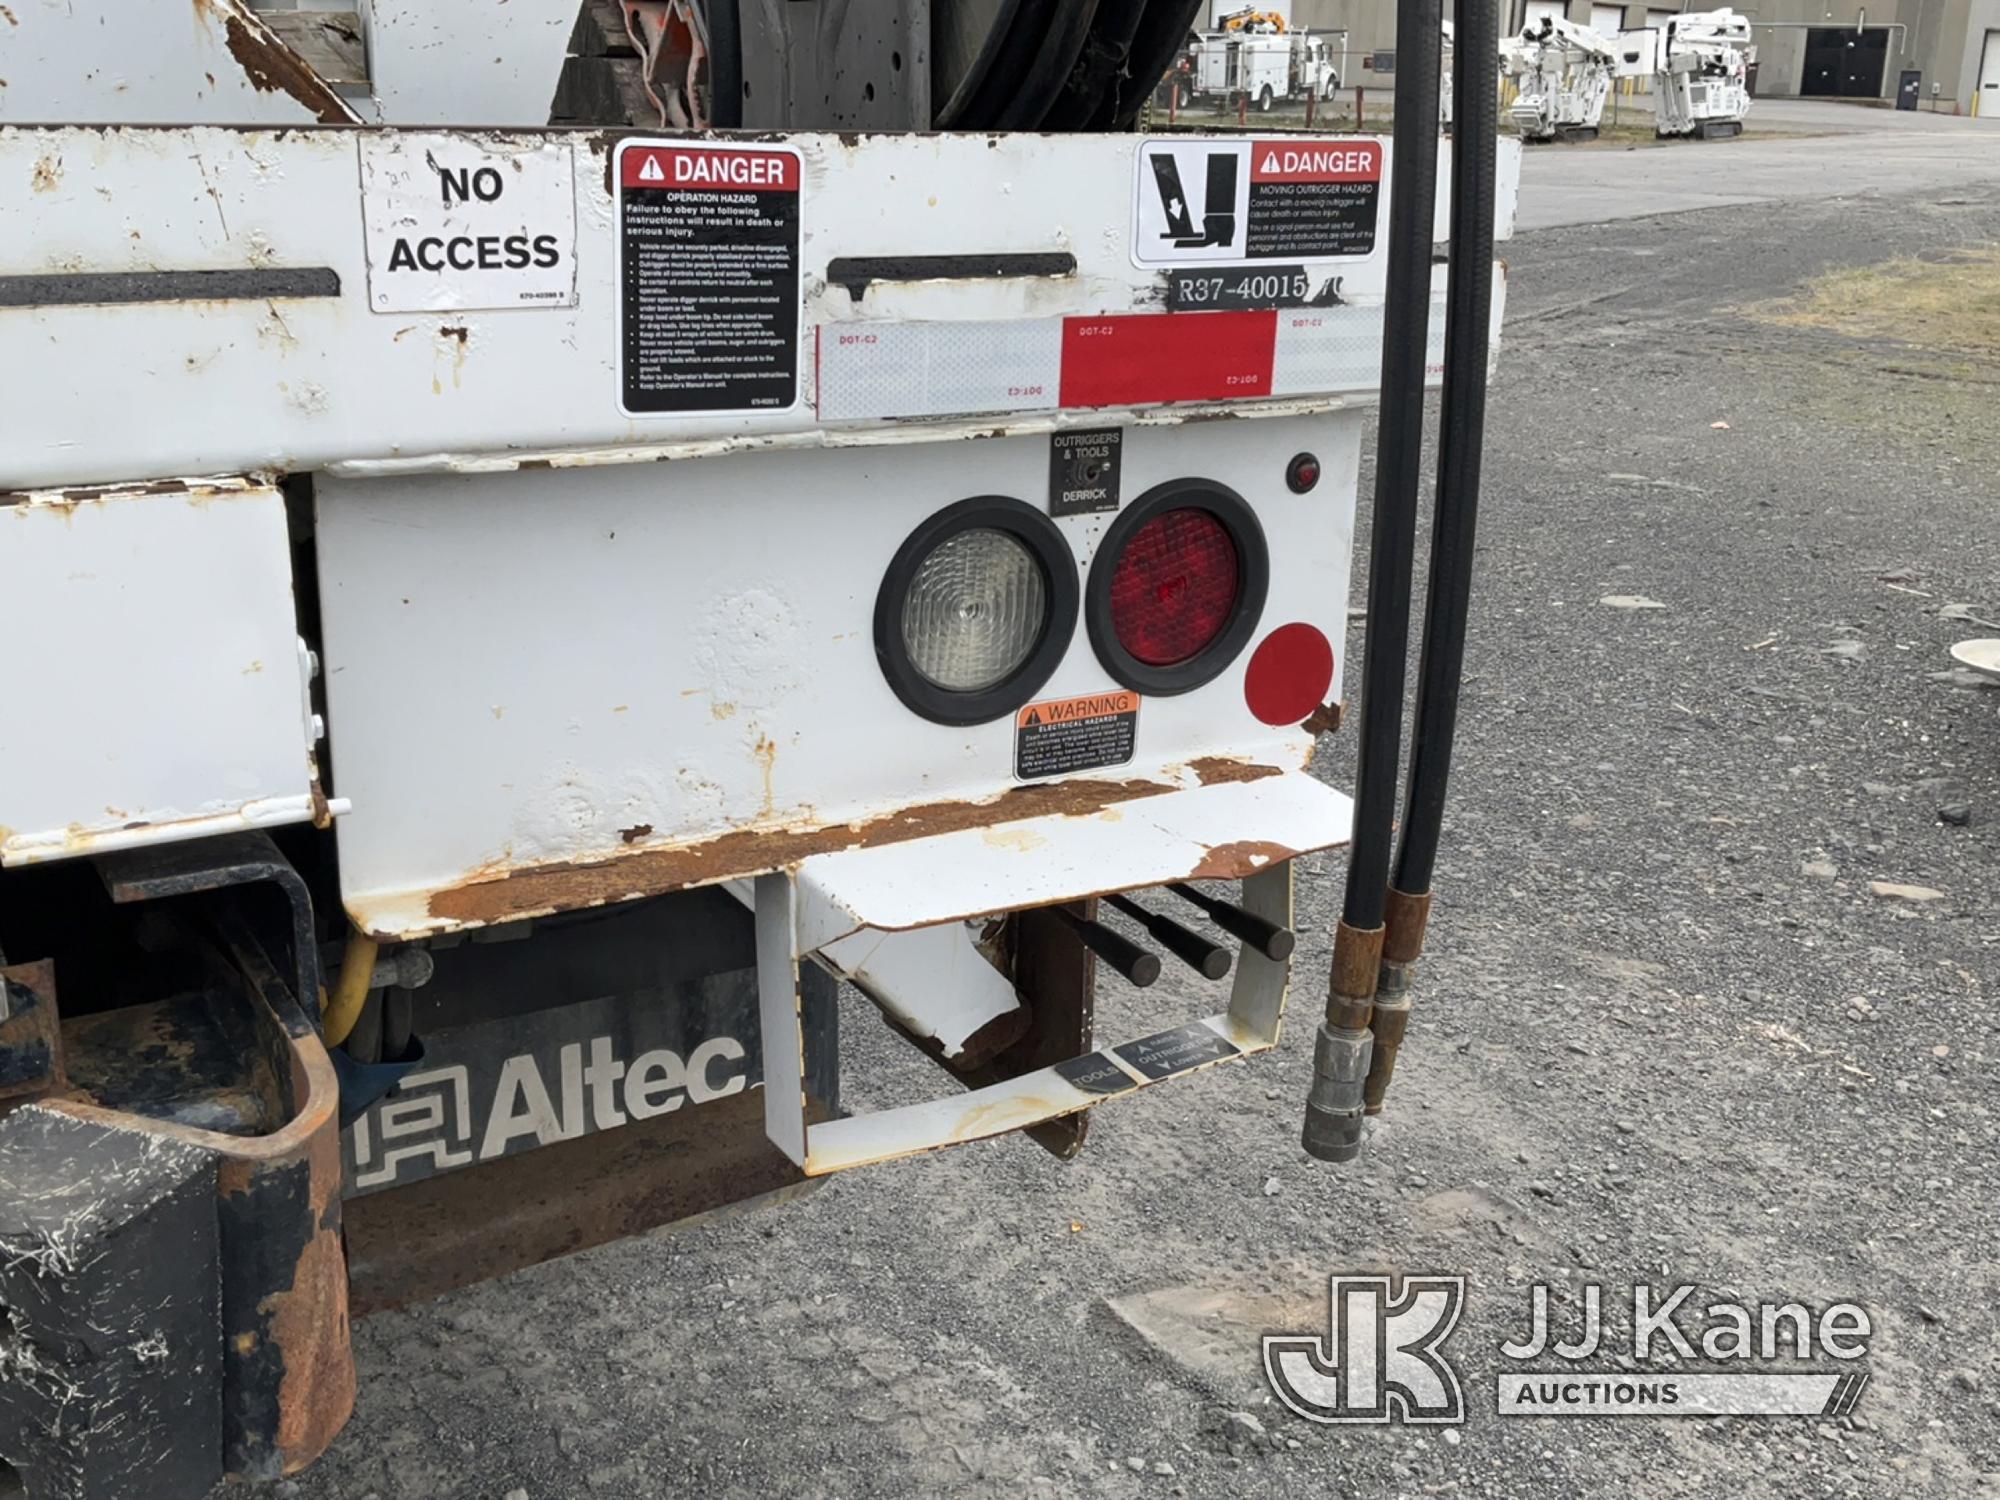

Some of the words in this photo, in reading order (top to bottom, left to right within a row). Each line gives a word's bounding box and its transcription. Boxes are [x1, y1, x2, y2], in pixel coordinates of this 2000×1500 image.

[1283, 151, 1372, 172] DANGER
[675, 155, 784, 184] DANGER
[440, 167, 503, 202] NO
[1260, 186, 1294, 195] MOVING
[1296, 185, 1340, 194] OUTRIGGER
[1342, 185, 1372, 194] HAZARD
[667, 193, 718, 203] OPERATION
[721, 194, 757, 203] HAZARD
[1251, 199, 1278, 207] Contact
[626, 204, 659, 212] Failure
[662, 204, 672, 213] to
[675, 205, 697, 215] obey
[701, 205, 715, 214] the
[718, 206, 760, 216] following
[626, 215, 684, 224] instructions
[687, 216, 703, 225] will
[706, 217, 733, 226] result
[736, 217, 744, 226] in
[747, 218, 772, 227] death
[775, 219, 784, 227] or
[627, 227, 662, 235] serious
[665, 227, 695, 237] injury.
[388, 235, 559, 272] ACCESS
[1080, 326, 1113, 336] DOT-C2
[839, 335, 877, 345] DOT-C2
[1226, 375, 1258, 385] DOT-C2
[1007, 386, 1043, 396] DOT-C2
[1054, 432, 1120, 448] OUTRIGGERS
[1063, 448, 1071, 460] &
[1075, 446, 1110, 459] TOOLS
[1063, 488, 1107, 502] DERRICK
[1048, 695, 1129, 721] WARNING
[1039, 720, 1083, 733] ELECTRICAL
[1072, 1065, 1121, 1087] TOOLS
[480, 1036, 746, 1159] Altec
